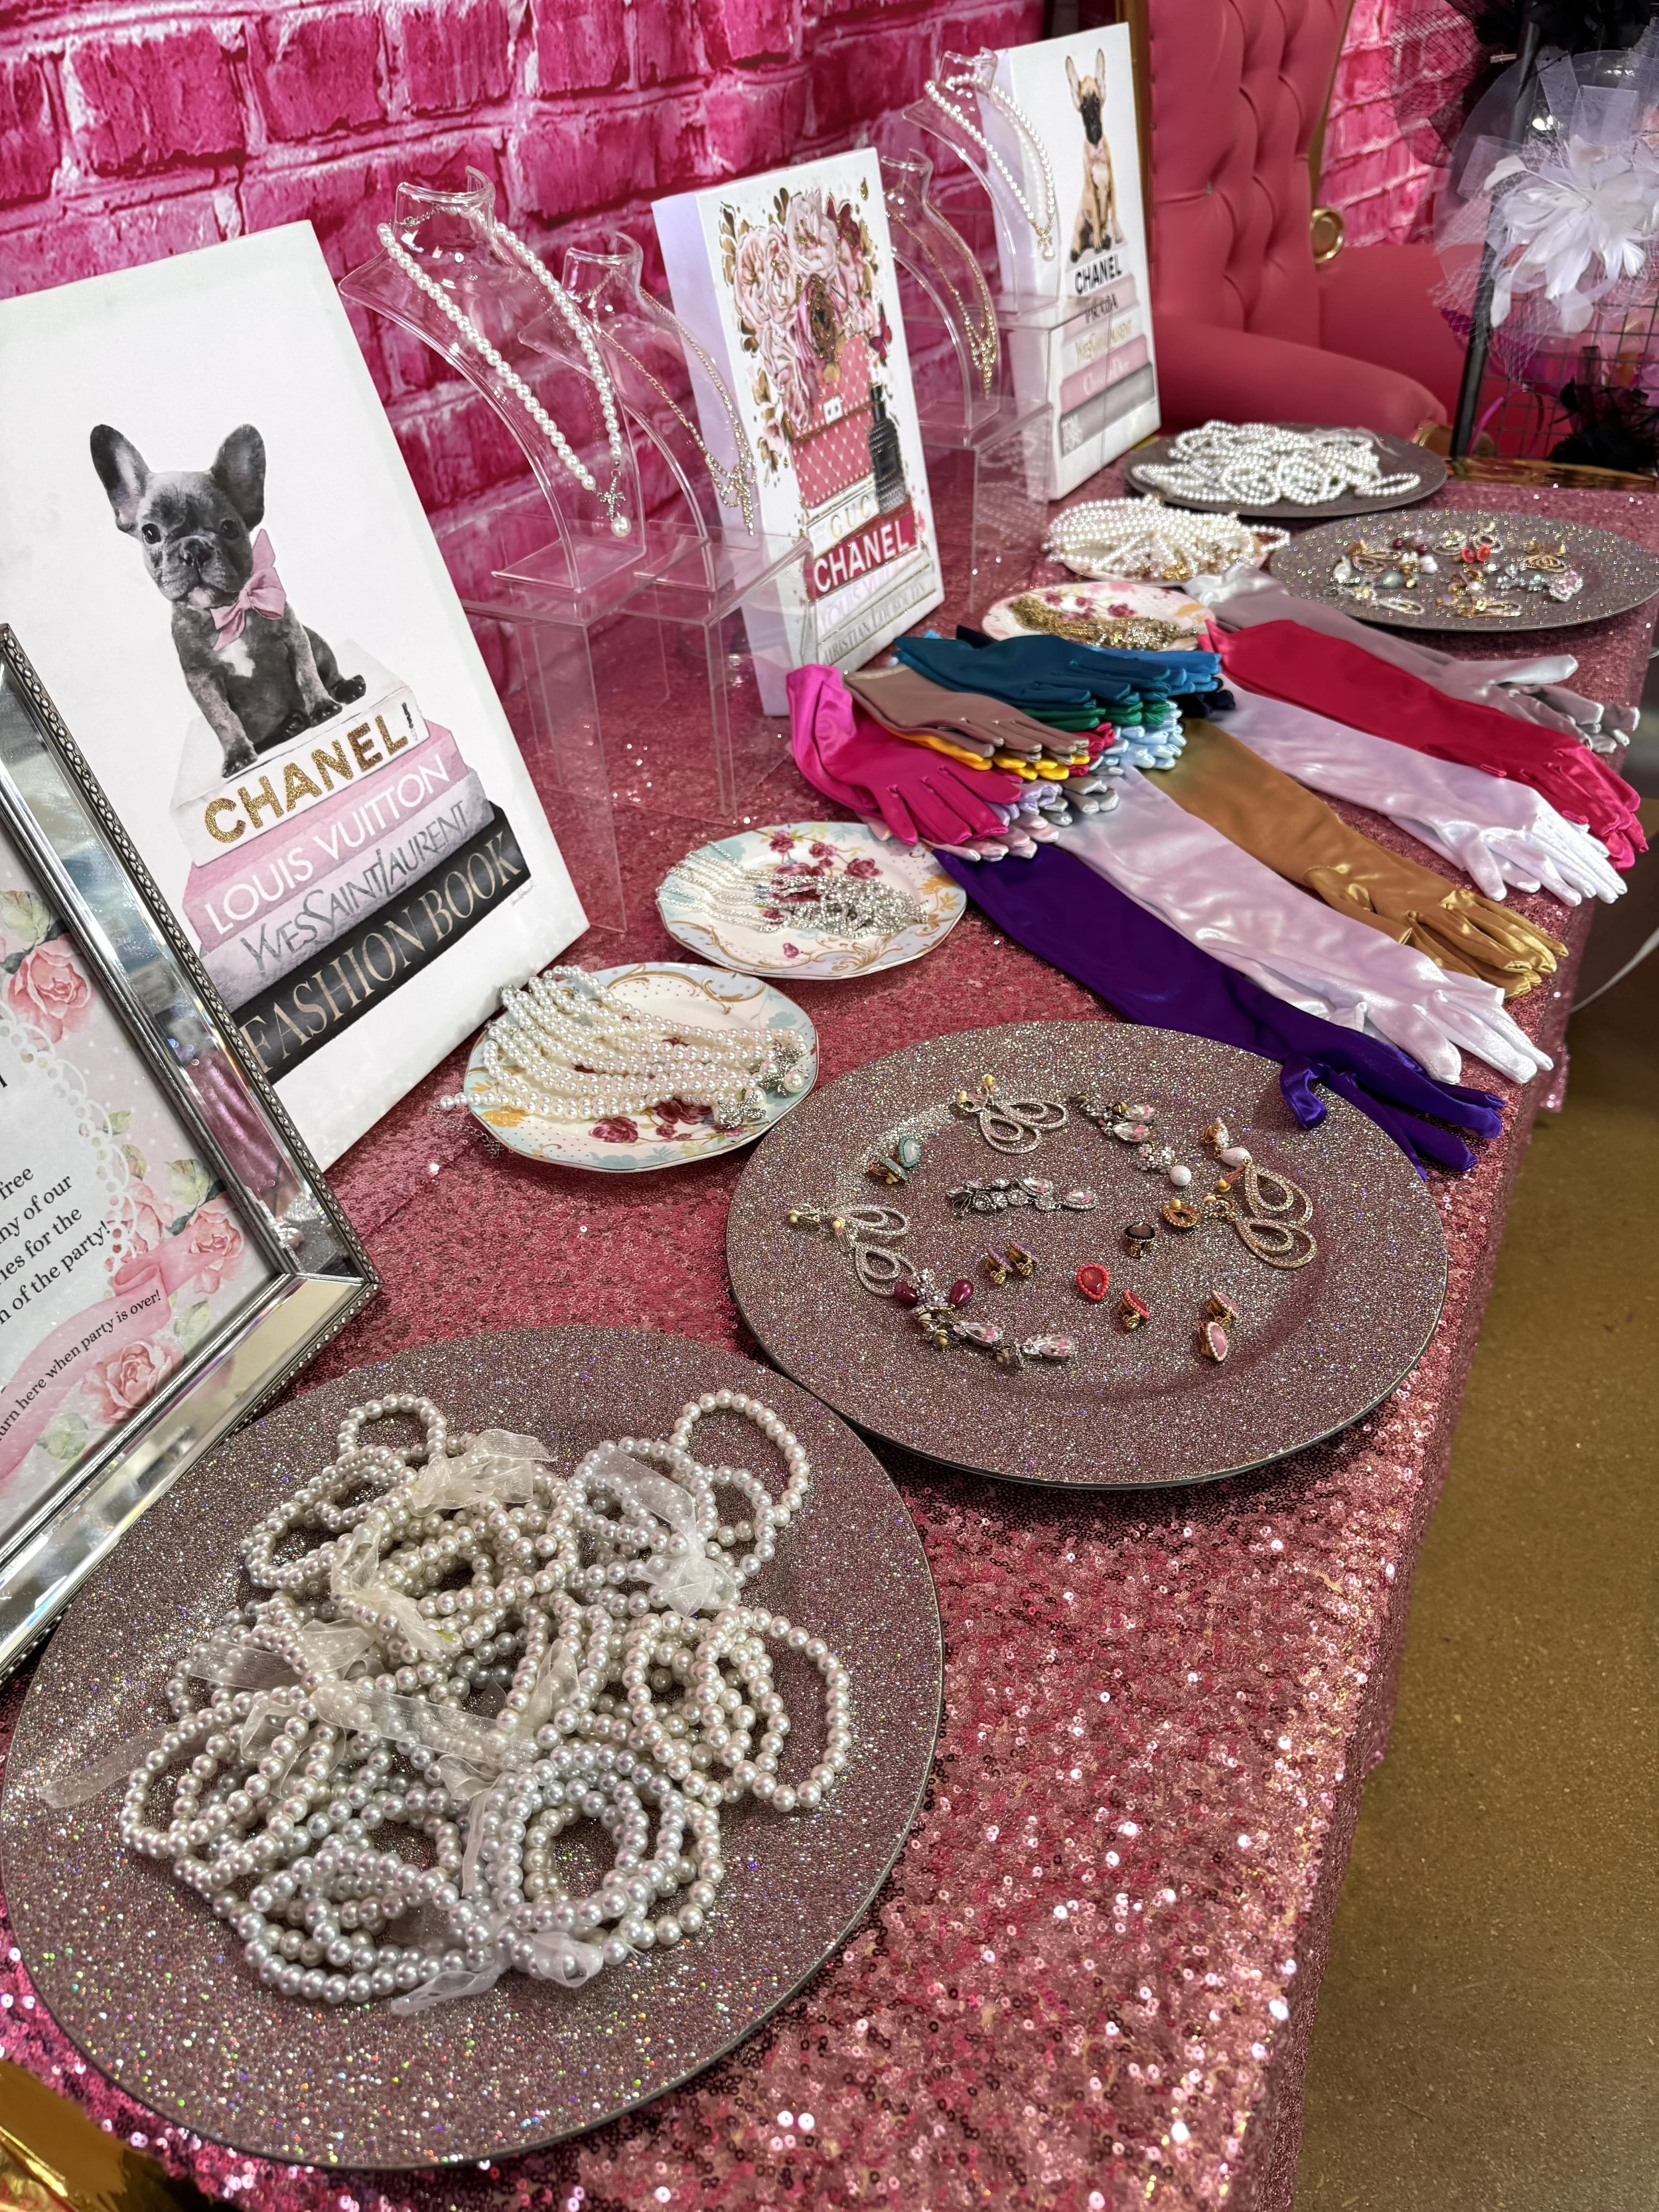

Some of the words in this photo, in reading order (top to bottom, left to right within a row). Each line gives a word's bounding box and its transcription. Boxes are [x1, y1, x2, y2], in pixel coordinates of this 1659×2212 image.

[1075, 254, 1122, 295] CHANEL
[814, 520, 910, 593] CHANEL
[204, 714, 409, 844] CHANEL
[205, 846, 314, 935] LOUIS
[313, 753, 450, 861] VUITTON
[239, 907, 423, 1073] FASHION
[419, 832, 521, 944] BOOK
[0, 1217, 21, 1244] ny
[24, 1195, 43, 1220] of
[44, 1175, 72, 1205] our
[25, 1231, 52, 1259] for
[52, 1207, 82, 1236] the
[13, 1285, 32, 1311] of
[31, 1266, 60, 1293] the
[60, 1220, 111, 1273] party!
[0, 1409, 21, 1440] urn
[15, 1378, 47, 1410] here
[45, 1345, 82, 1378] when
[80, 1317, 115, 1352] party
[115, 1311, 129, 1324] is
[130, 1289, 162, 1315] over!
